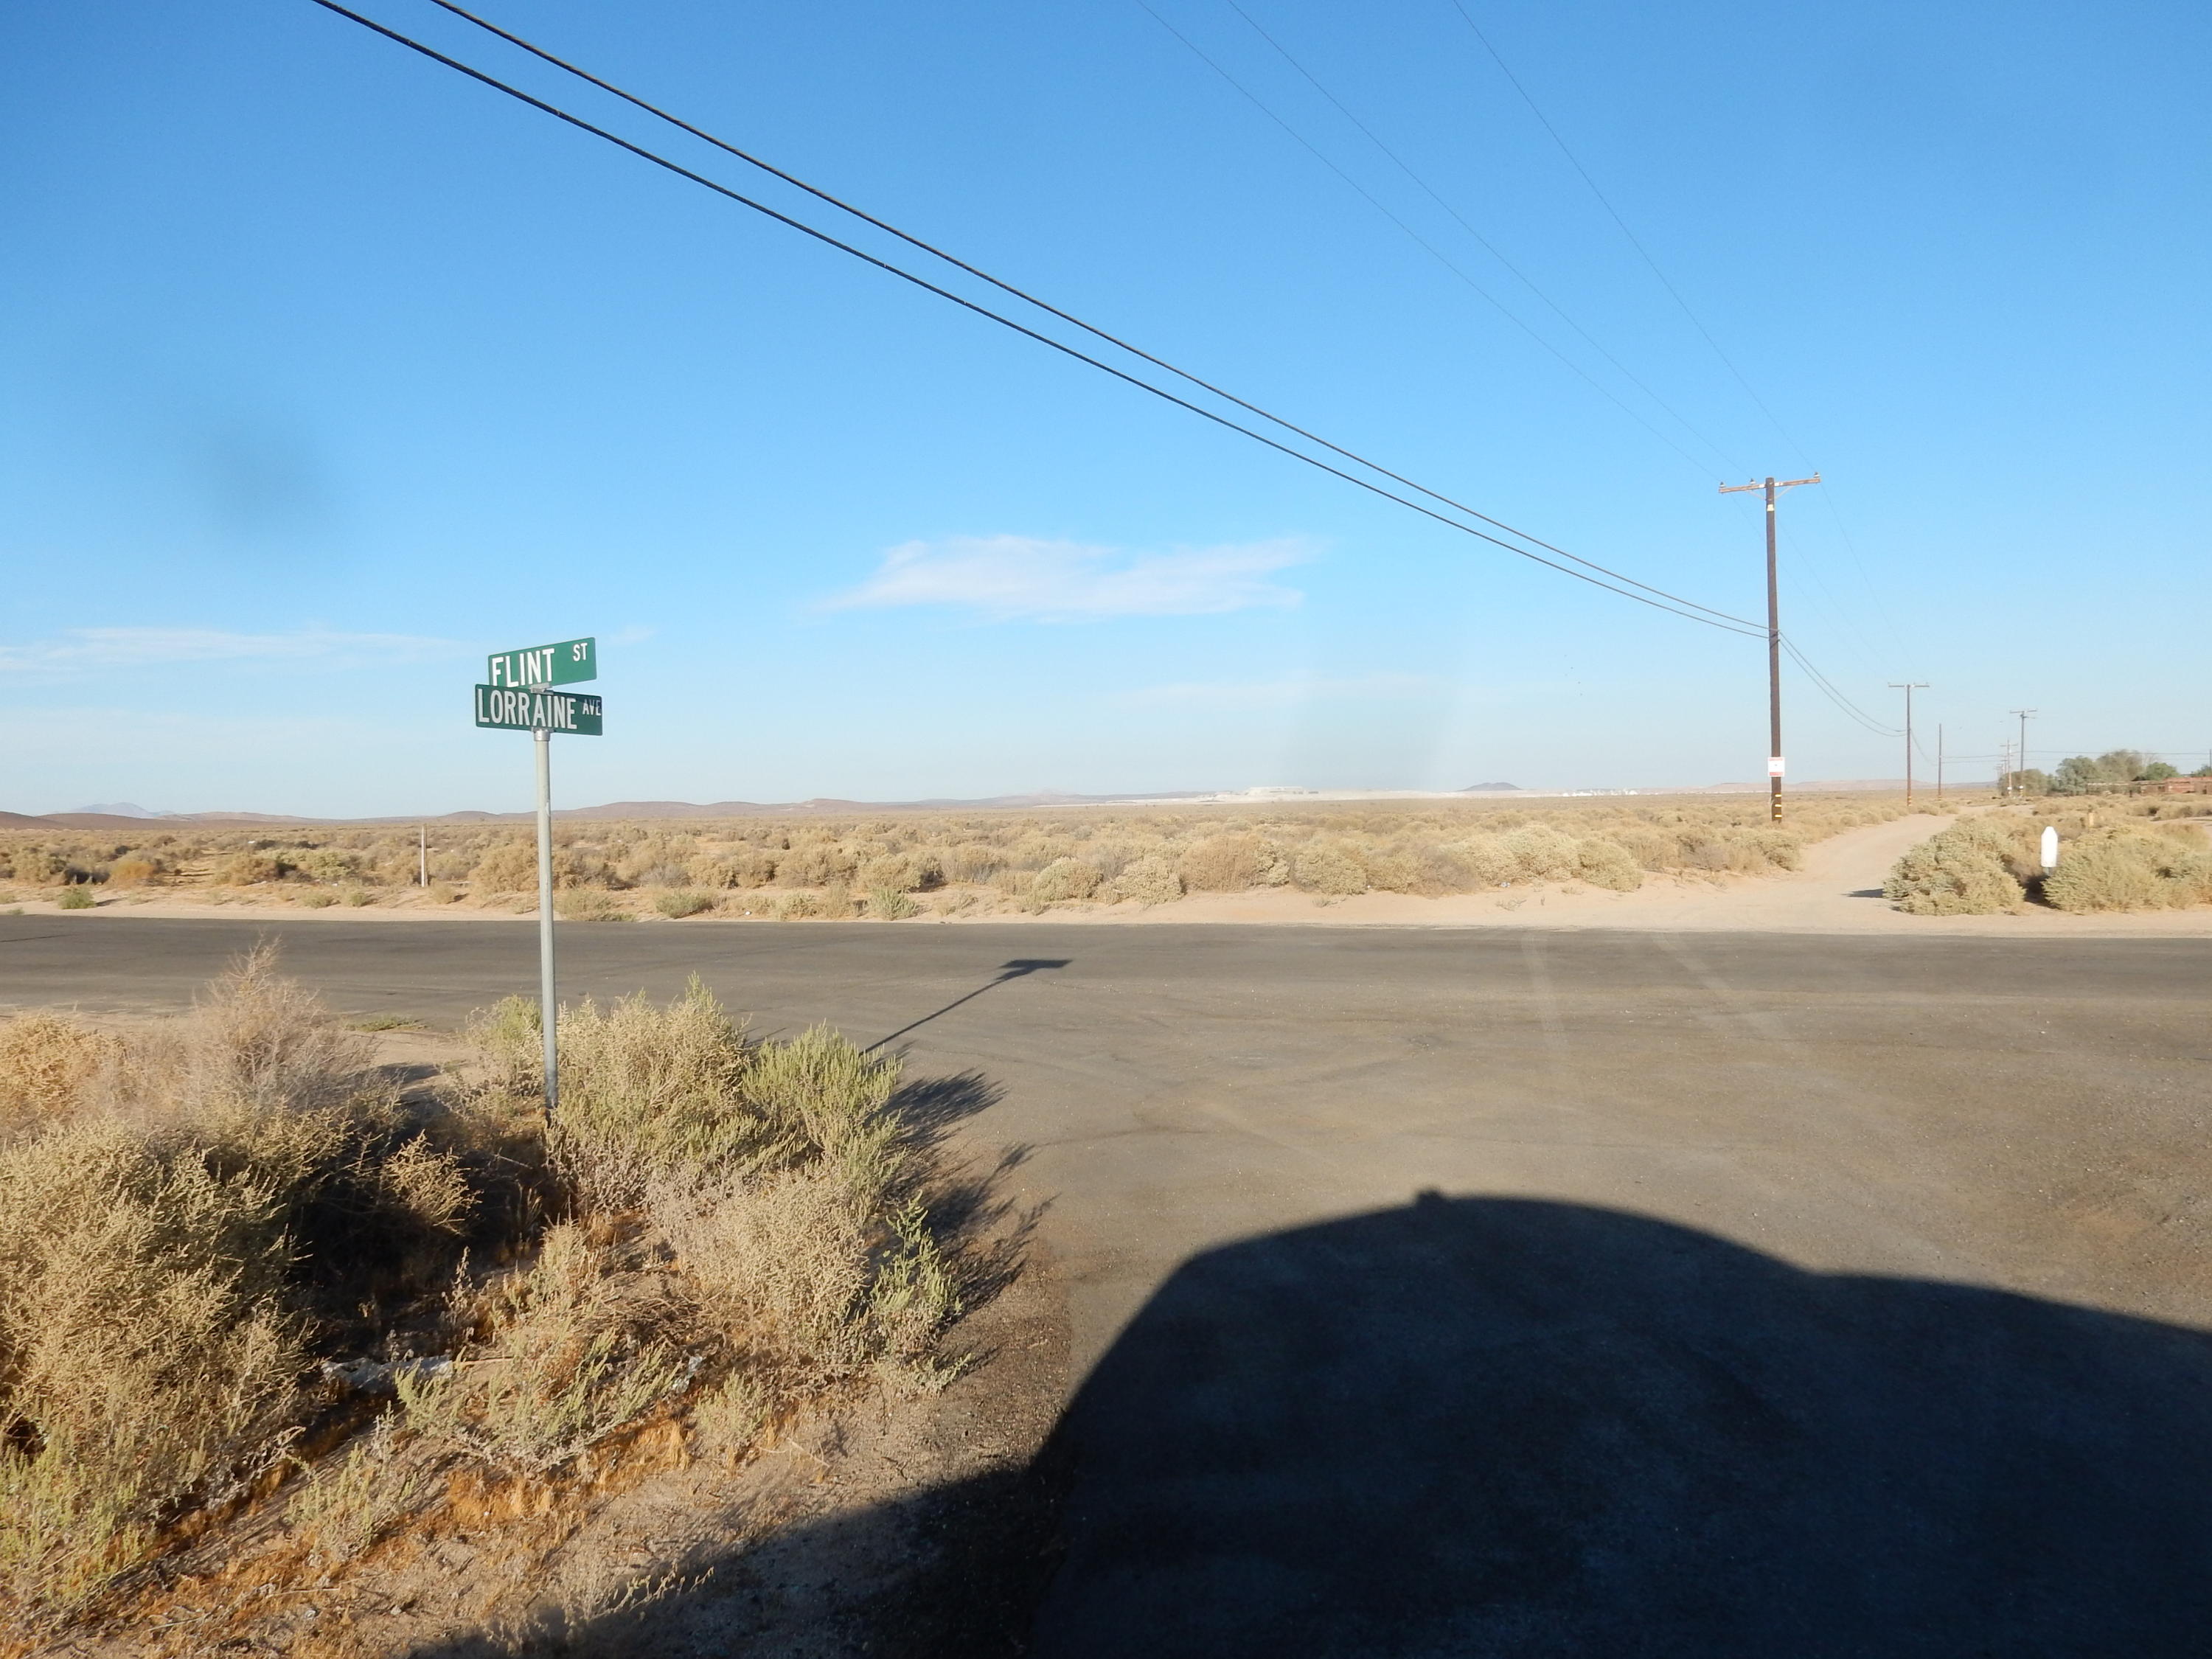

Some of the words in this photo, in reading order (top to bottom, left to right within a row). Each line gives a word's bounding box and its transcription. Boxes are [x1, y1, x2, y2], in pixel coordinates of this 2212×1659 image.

[492, 648, 554, 688] FLINT
[573, 643, 588, 661] ST
[478, 689, 577, 729] LORRAINE
[582, 699, 602, 716] AVE
